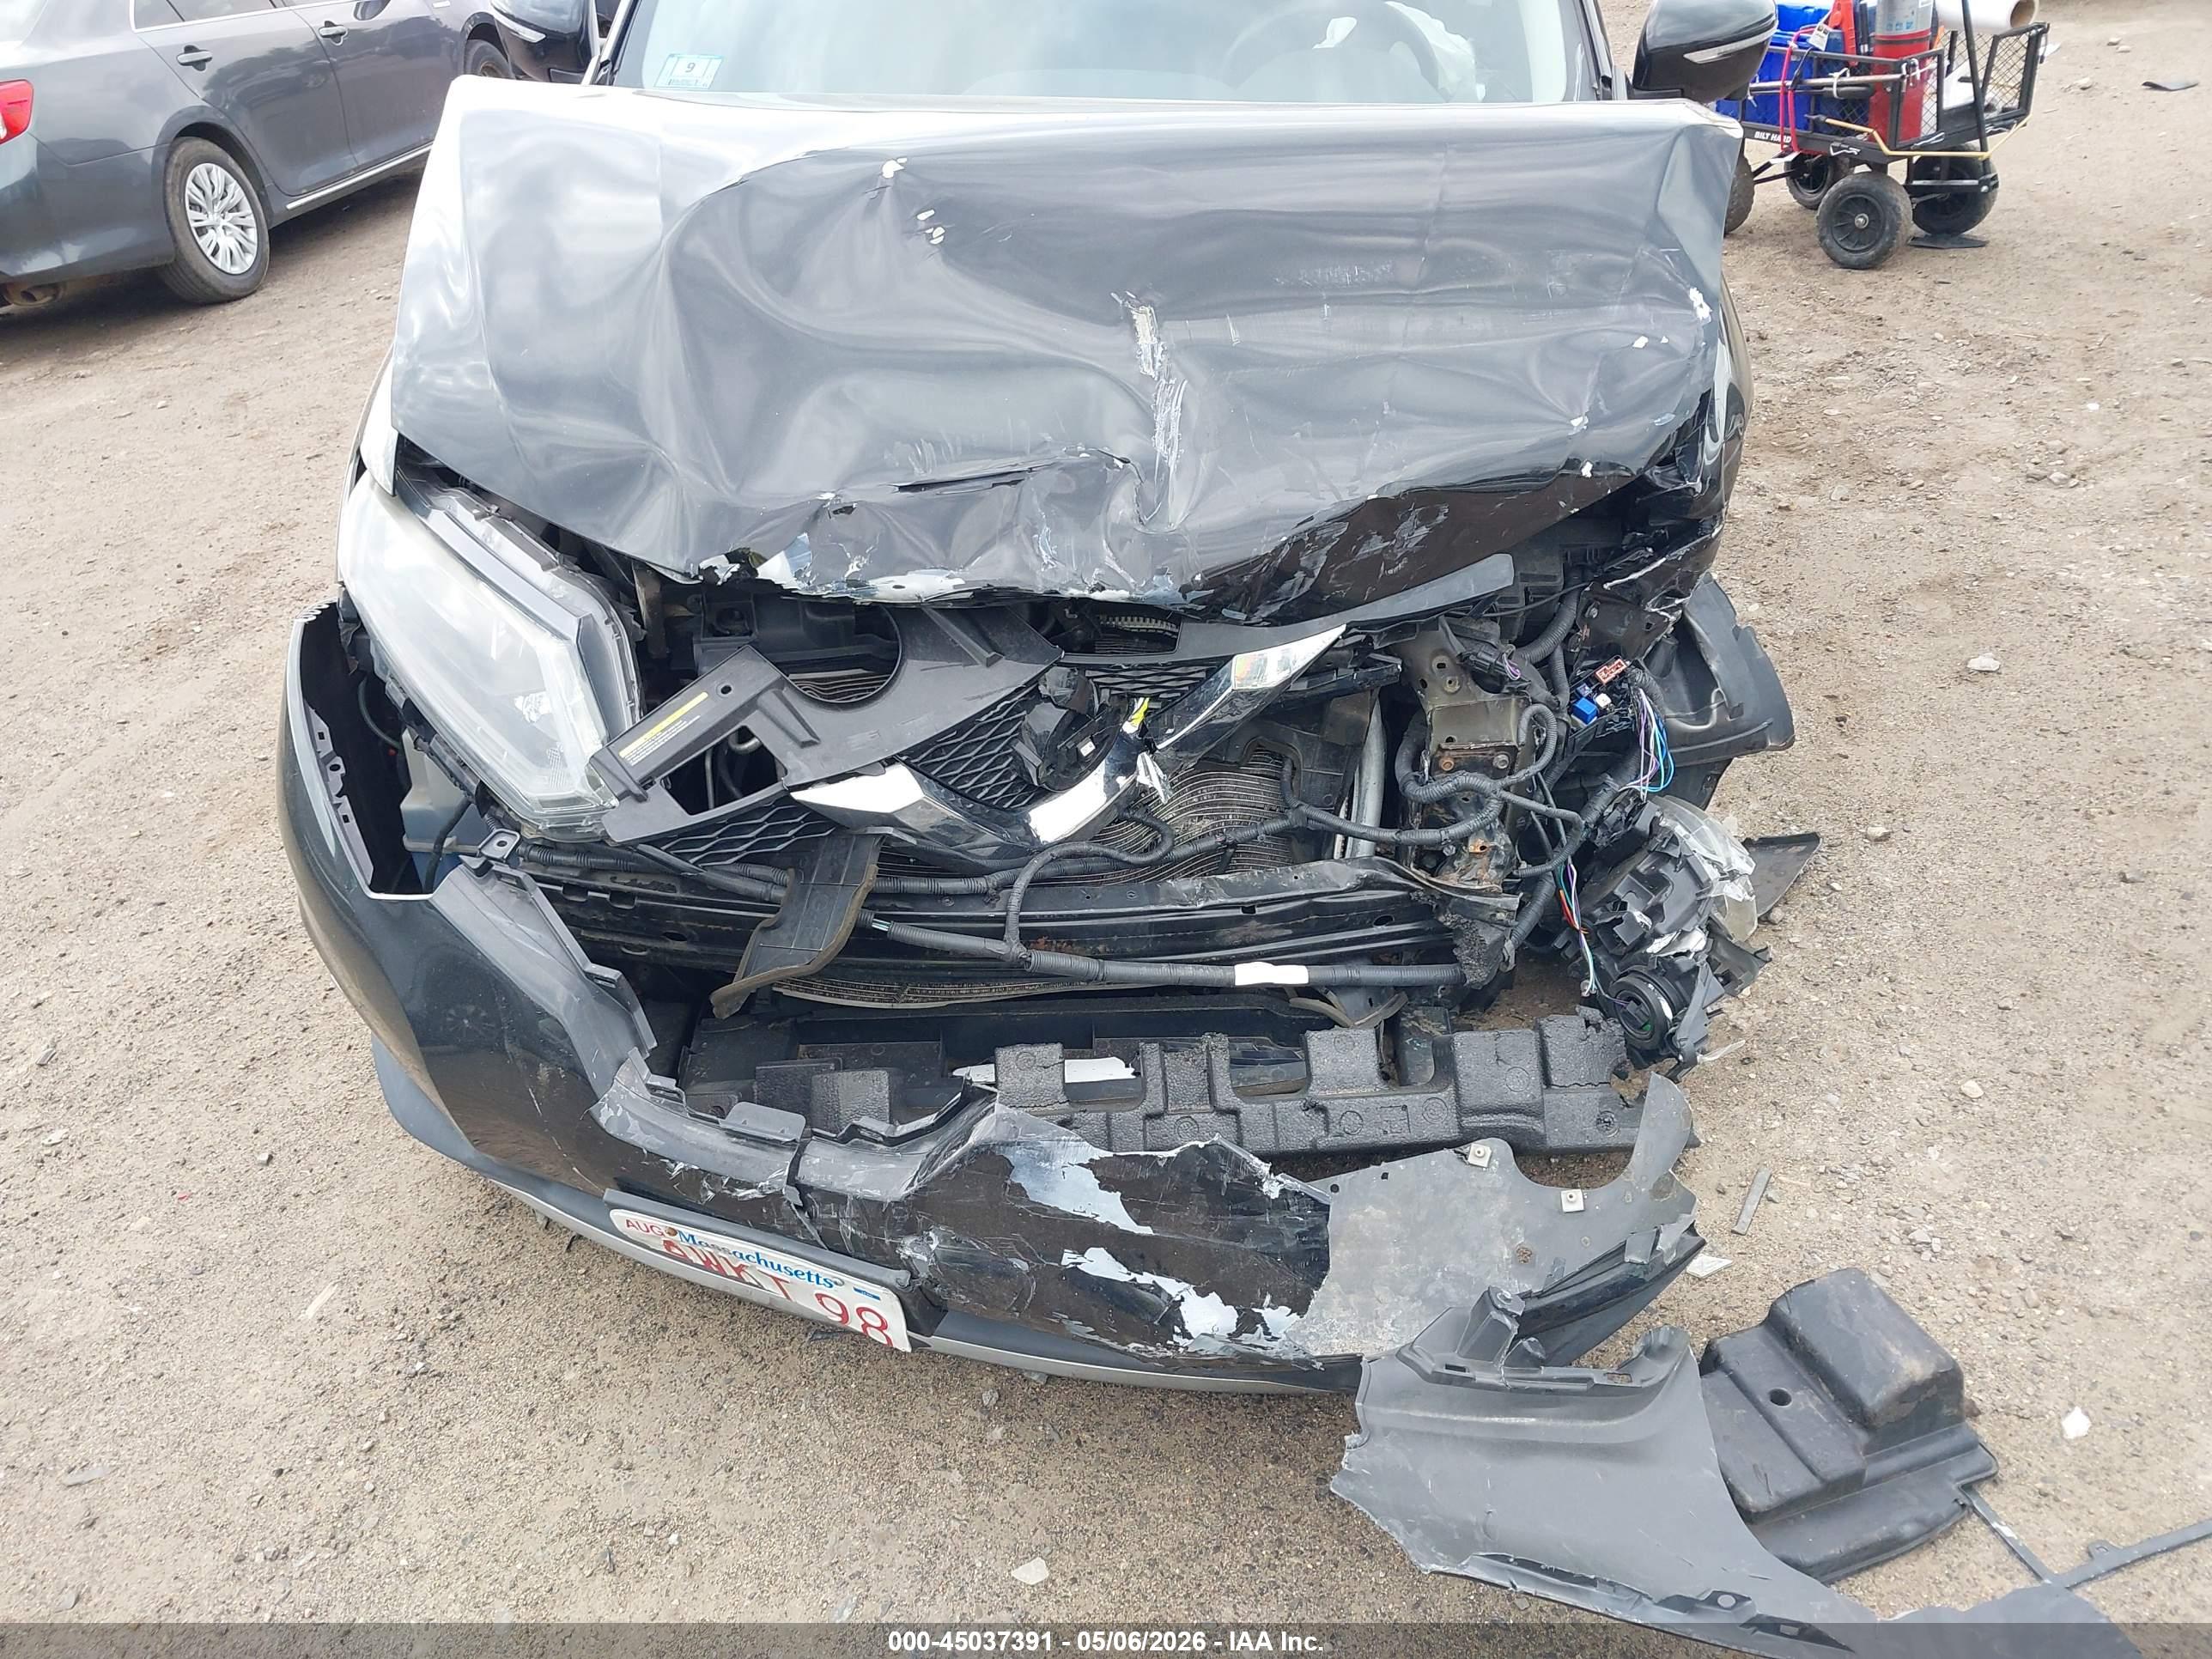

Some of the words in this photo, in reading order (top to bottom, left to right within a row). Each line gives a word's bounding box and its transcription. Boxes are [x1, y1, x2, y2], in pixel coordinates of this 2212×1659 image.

[685, 62, 696, 73] 9
[1754, 131, 1771, 140] BILT
[625, 1218, 665, 1238] AUG
[678, 1231, 836, 1290] Massachusetts
[814, 1291, 894, 1348] 98
